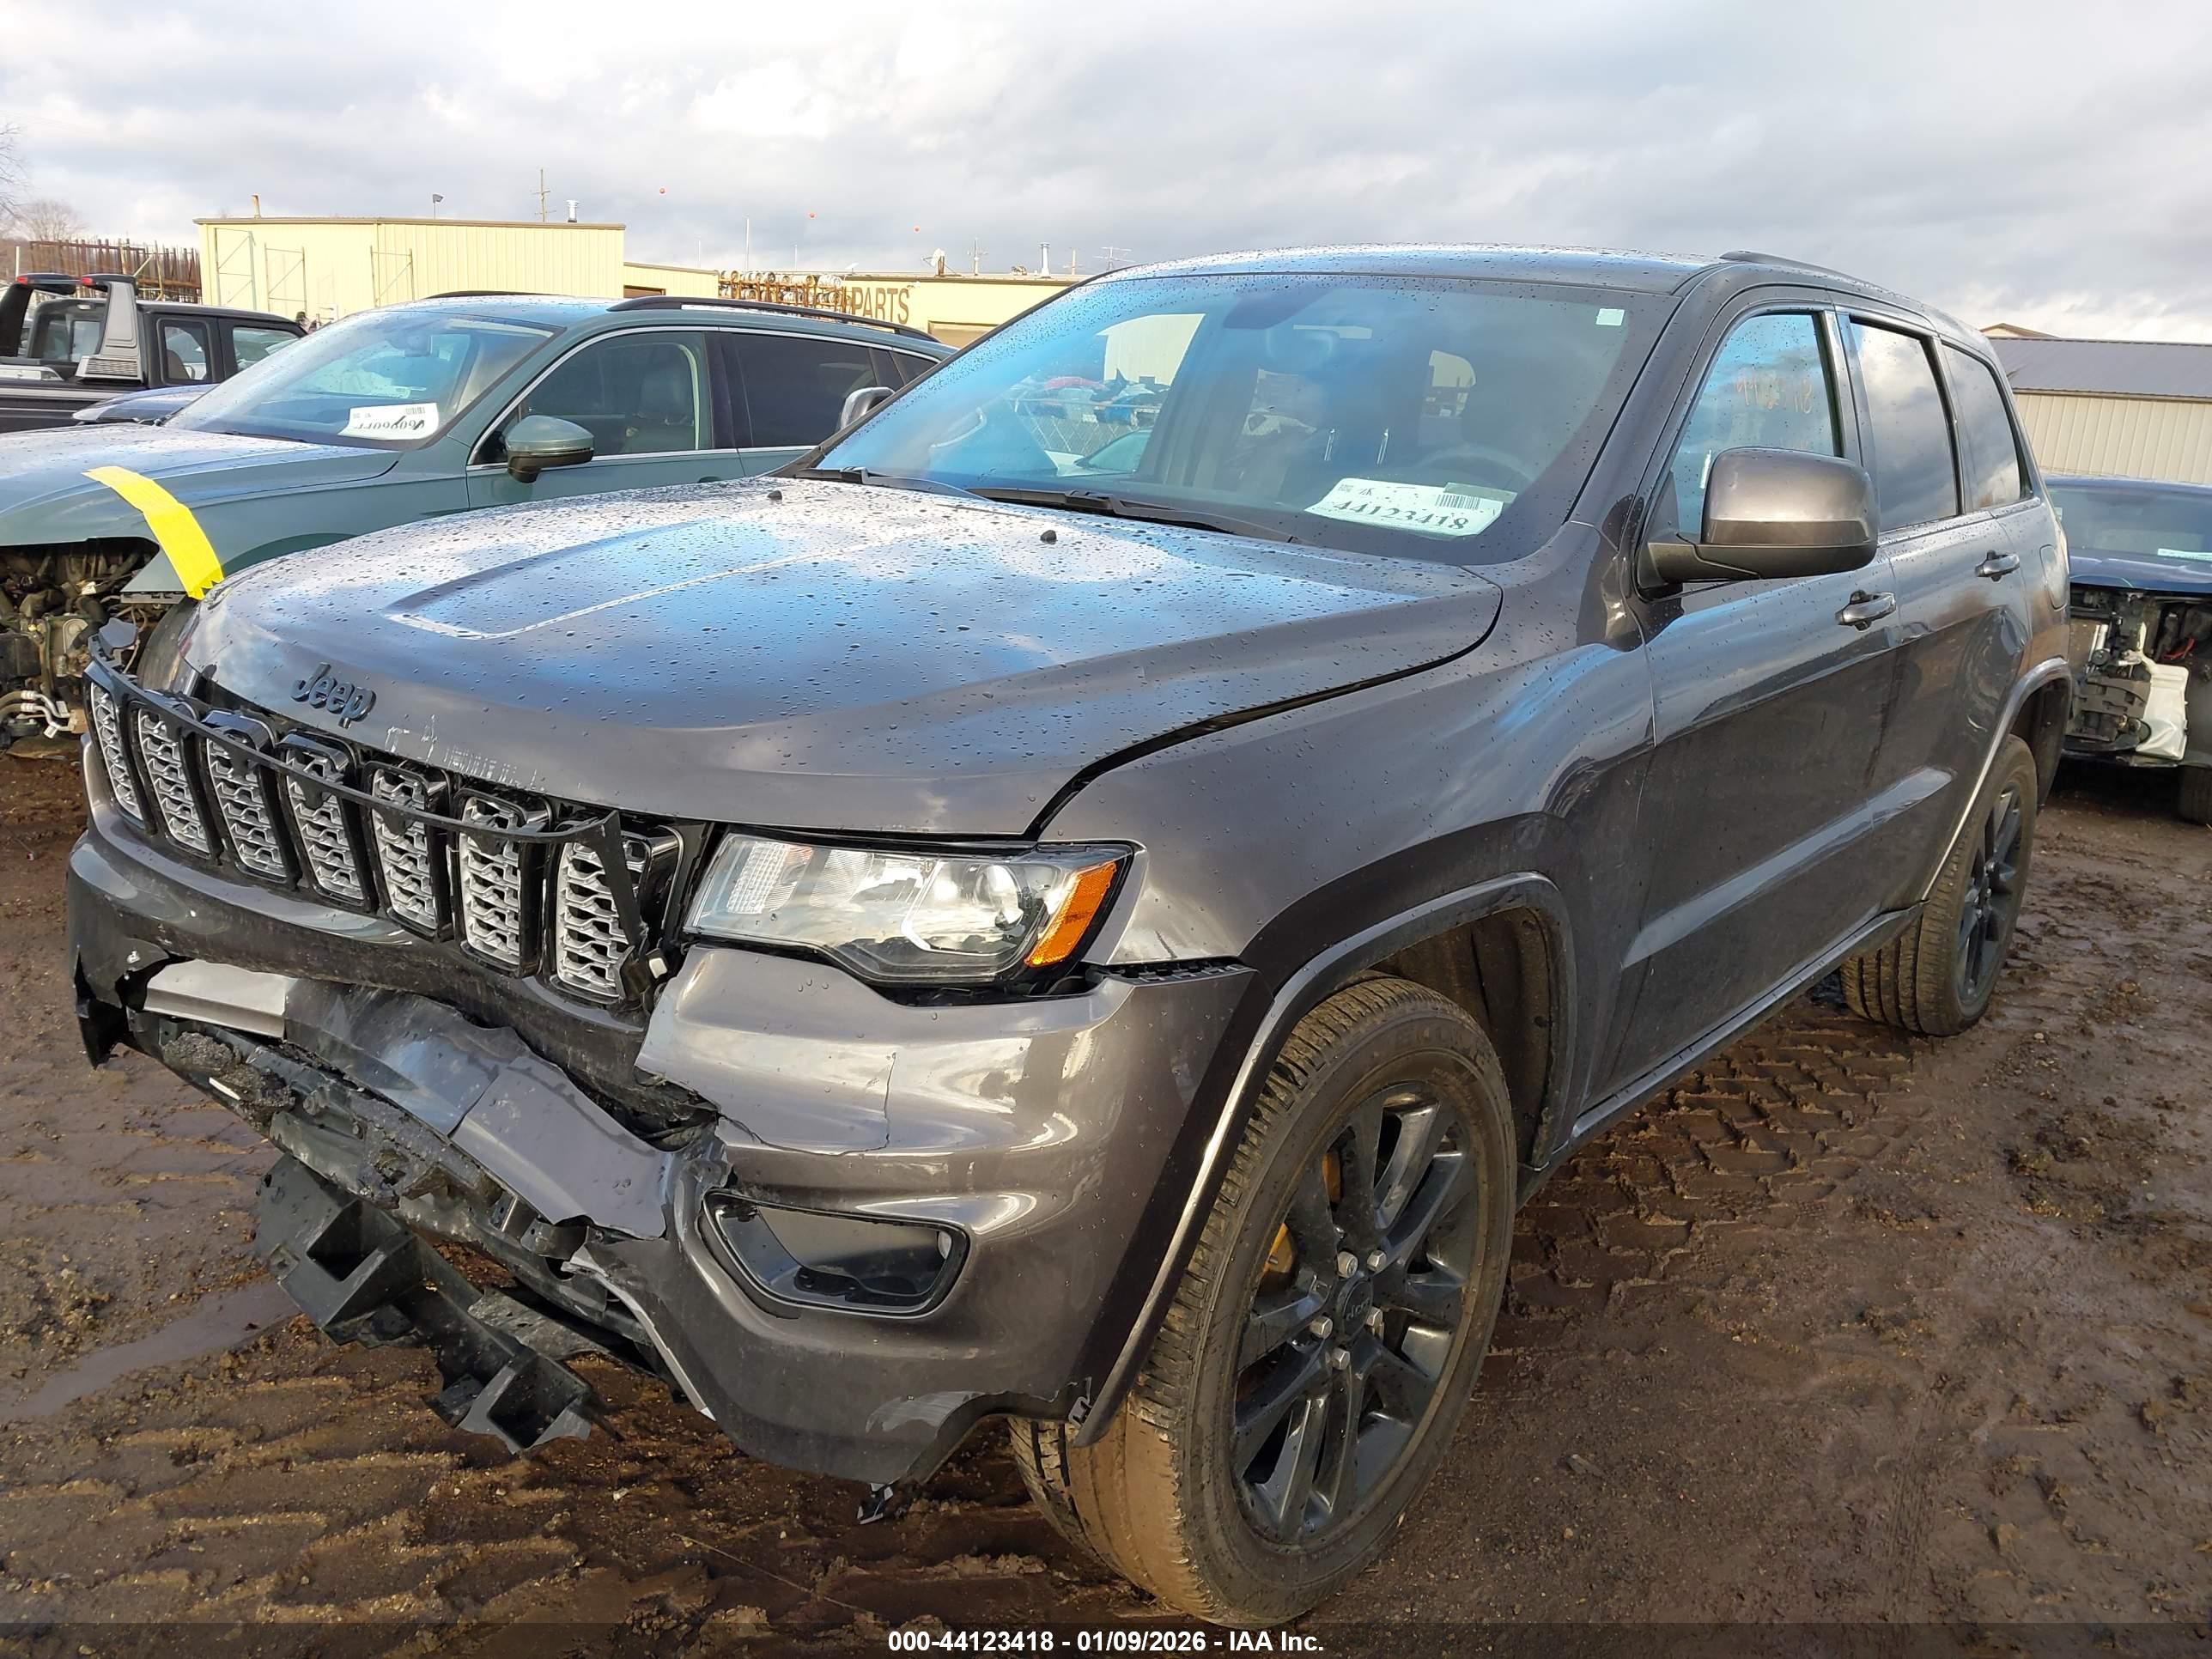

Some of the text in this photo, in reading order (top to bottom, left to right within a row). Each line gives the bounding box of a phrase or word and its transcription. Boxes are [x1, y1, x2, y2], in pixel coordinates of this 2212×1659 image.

[851, 287, 909, 325] PARTS
[1334, 501, 1469, 530] 44123418
[291, 662, 376, 729] Jeep
